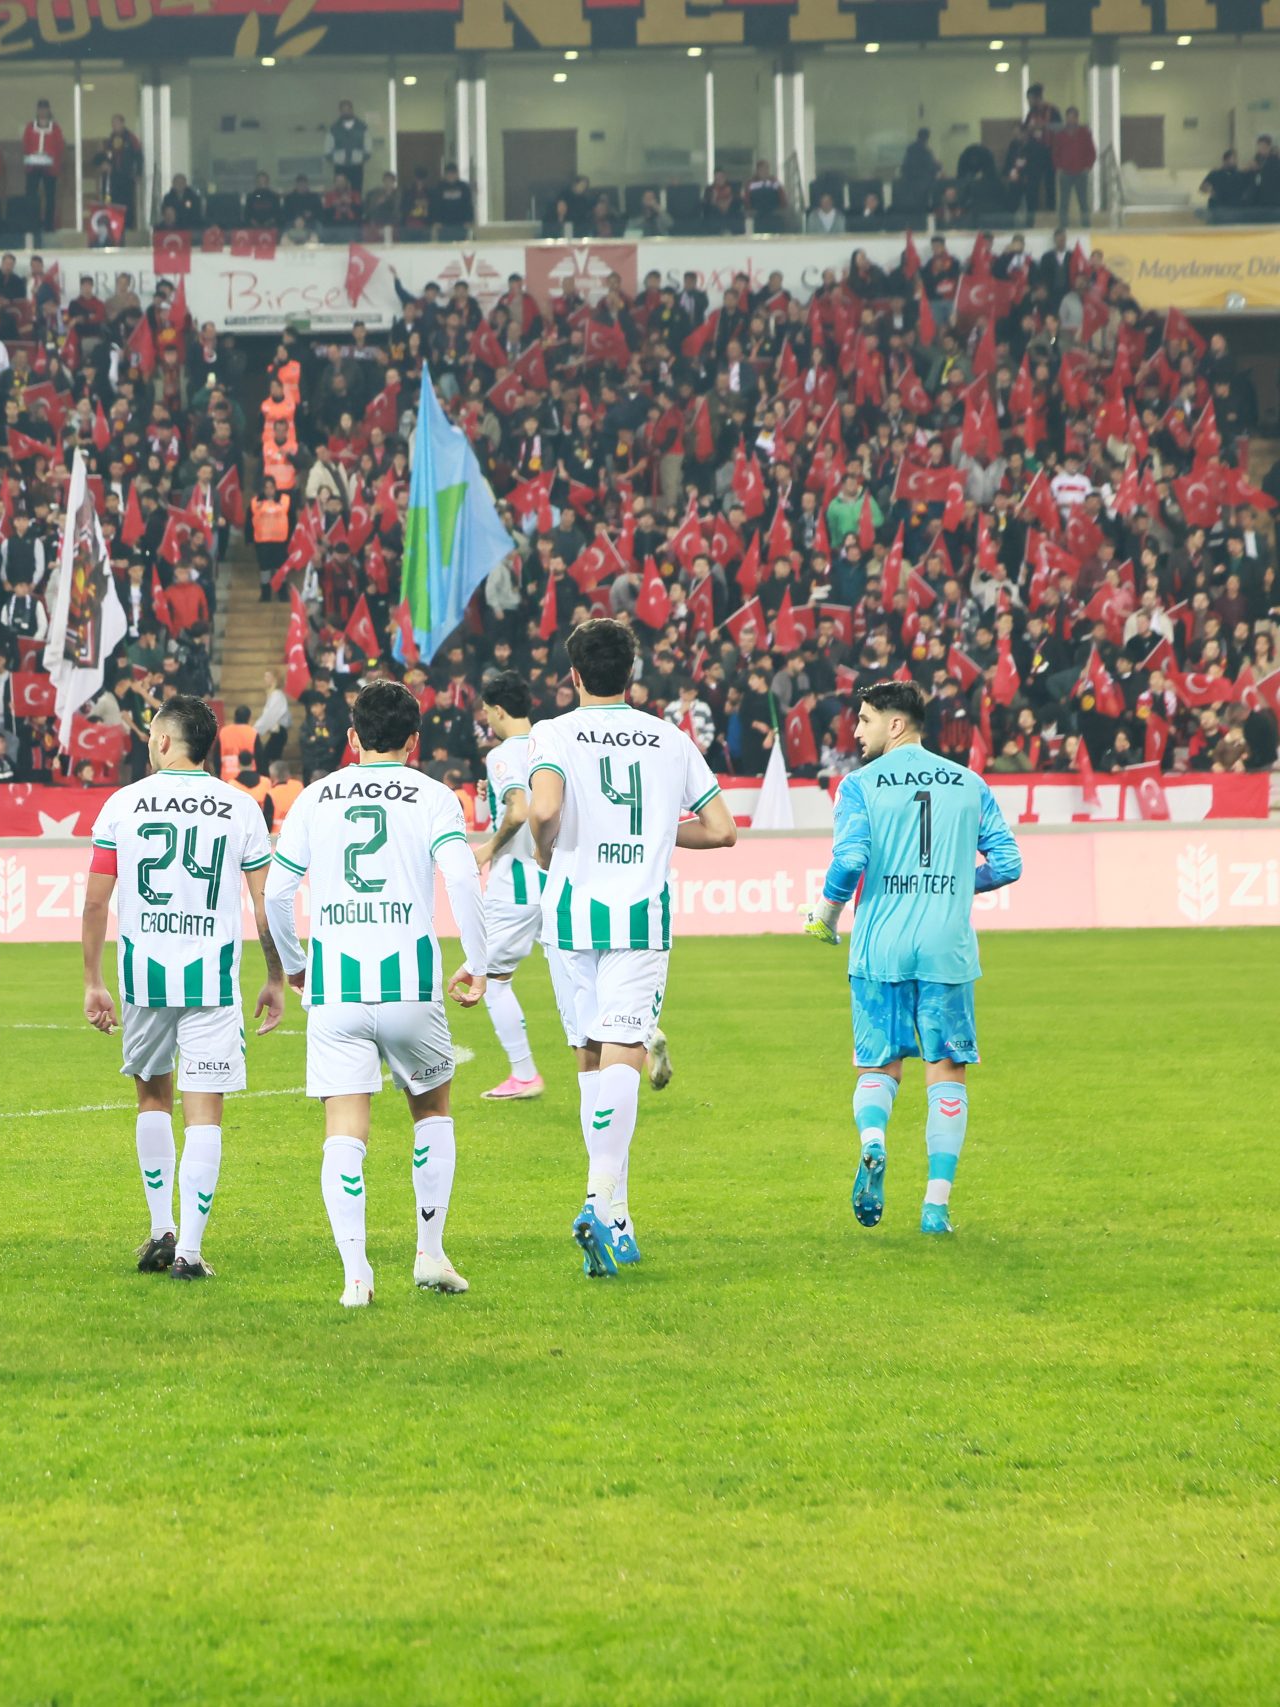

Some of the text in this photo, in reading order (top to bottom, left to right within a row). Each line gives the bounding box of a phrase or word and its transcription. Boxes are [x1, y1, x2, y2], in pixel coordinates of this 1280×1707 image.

[220, 270, 376, 313] Birse
[576, 729, 661, 749] ALAGÖZ
[876, 767, 965, 788] ALAGÖZ
[318, 780, 419, 804] ALAGÖZ
[599, 755, 643, 836] 4
[133, 795, 233, 820] ALAGÖZ
[913, 790, 932, 869] 1
[344, 804, 388, 893] 2
[597, 842, 645, 864] ARDA
[137, 822, 228, 911] 24
[671, 870, 794, 915] iraat
[882, 874, 956, 896] TAHA TEPE
[320, 899, 413, 926] MOĞULTAY
[613, 1014, 642, 1026] DELTA
[198, 1061, 231, 1071] DELTA
[424, 1060, 450, 1077] DELTA
